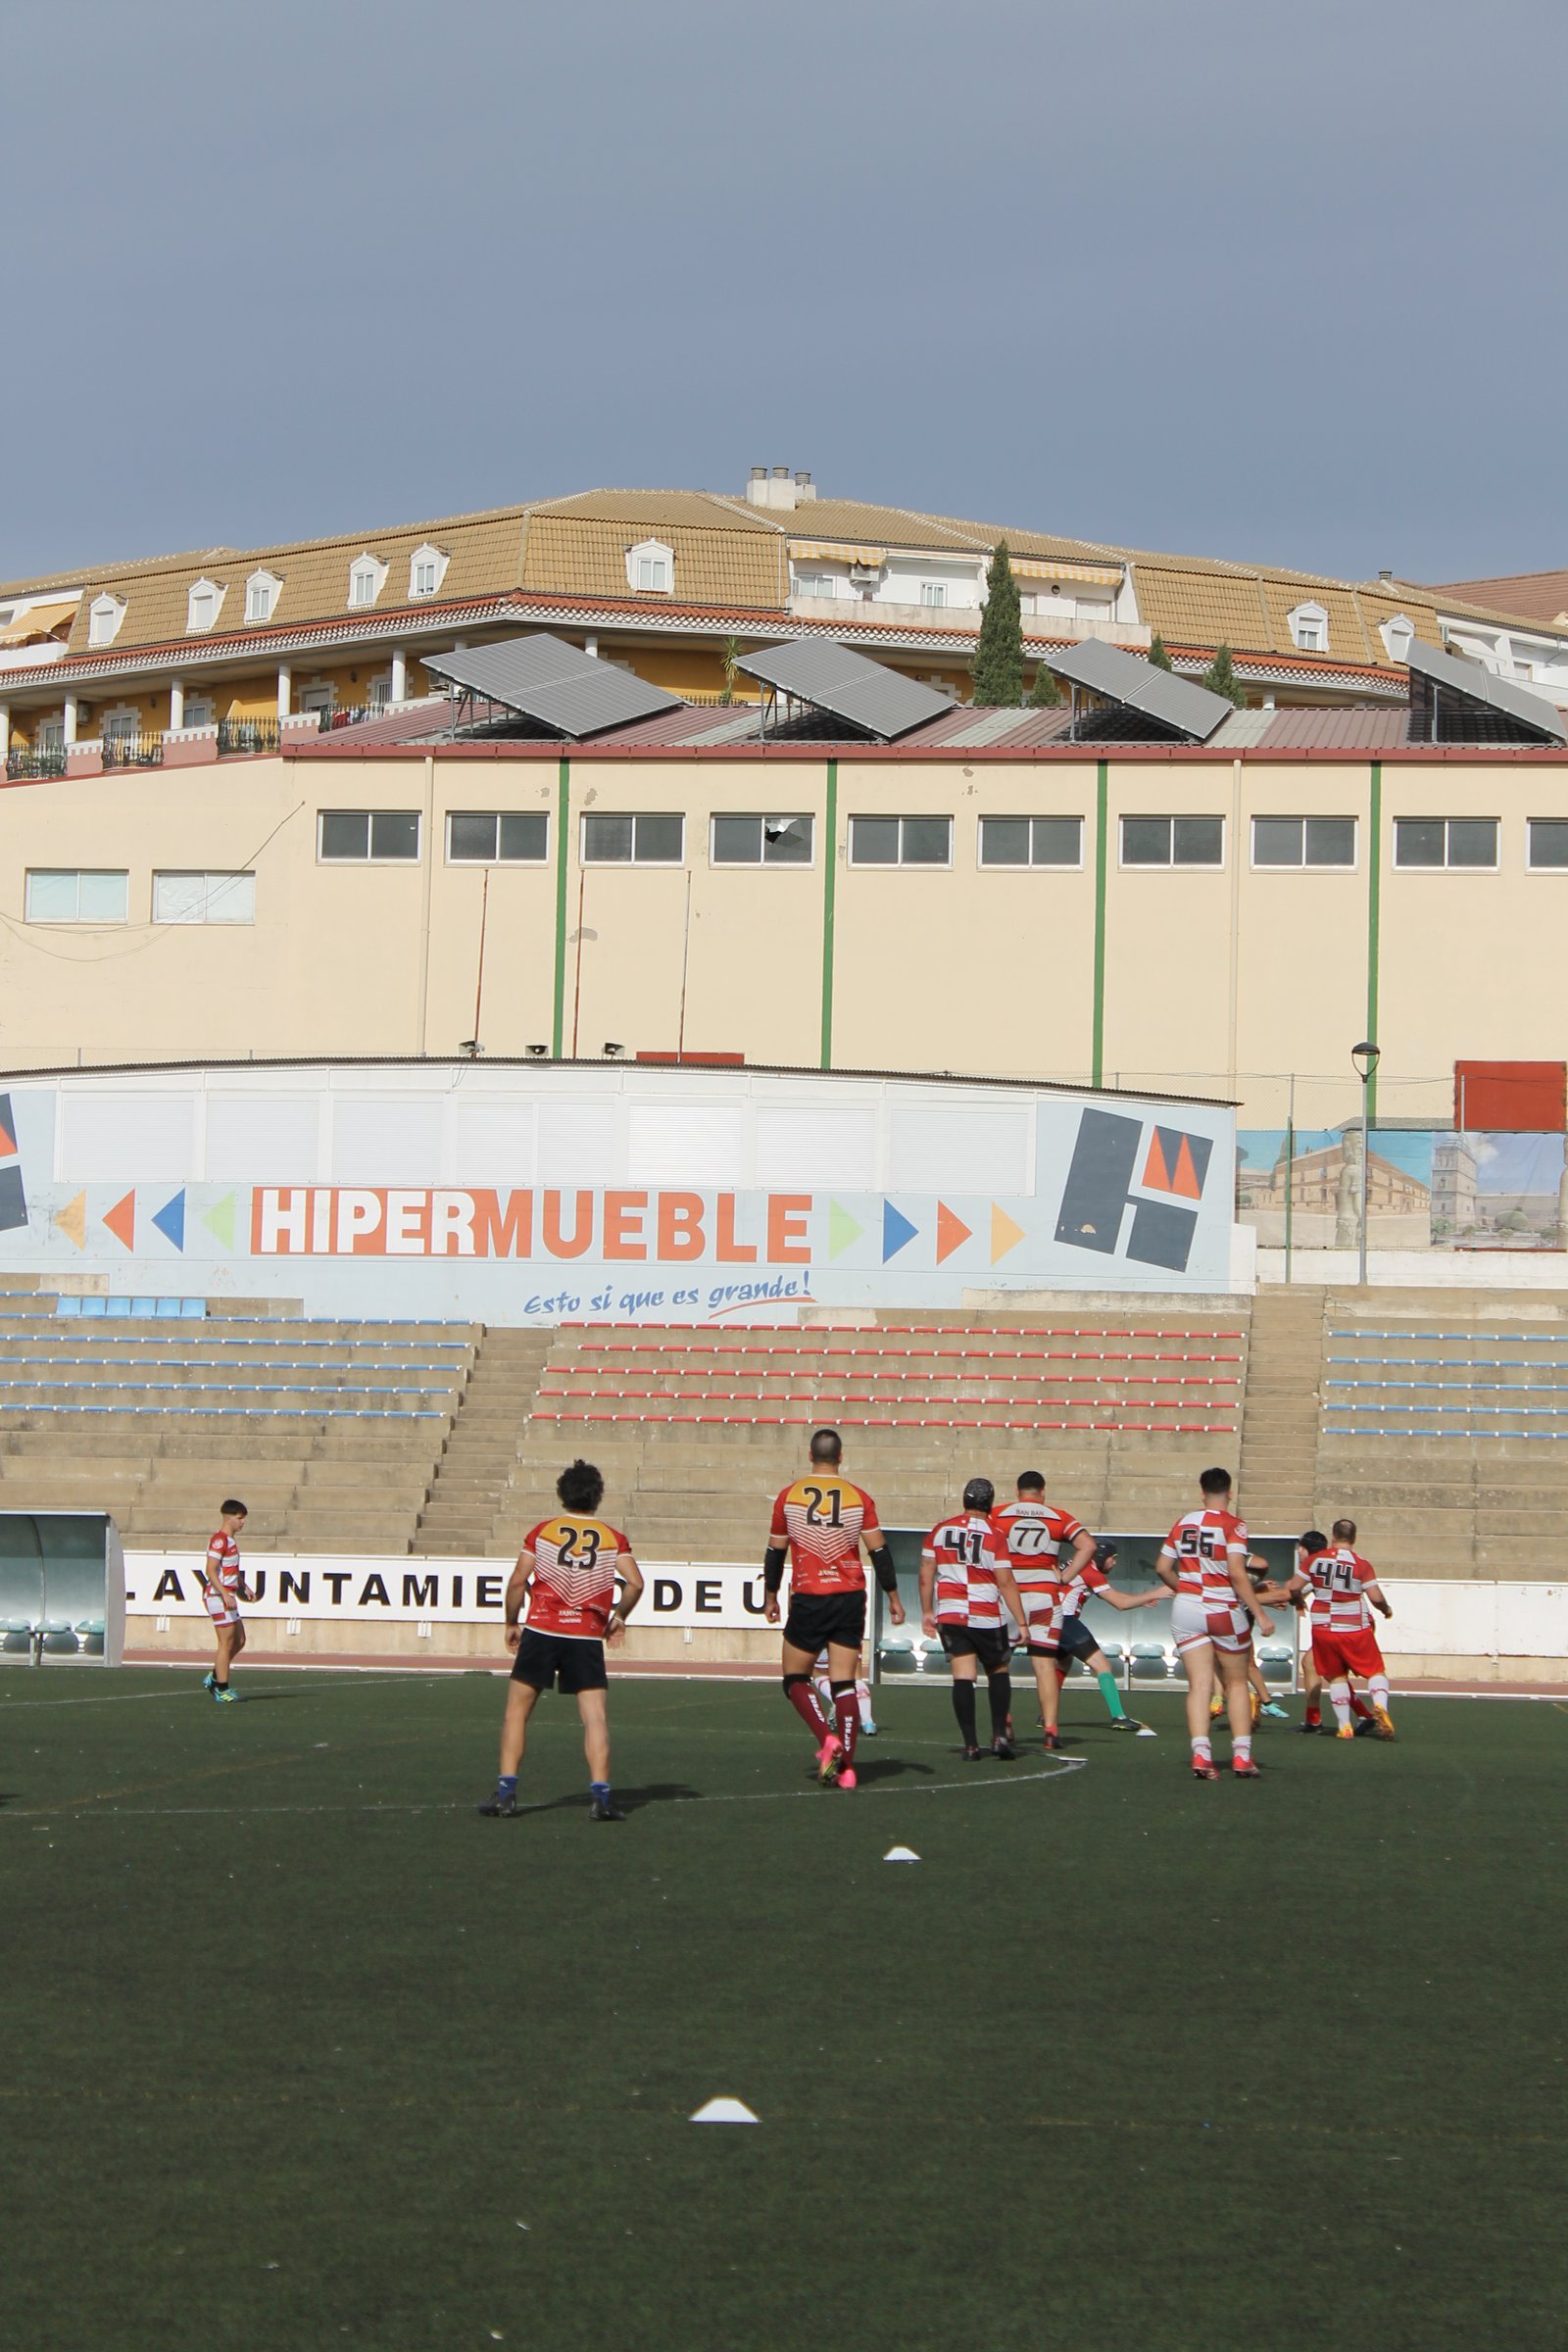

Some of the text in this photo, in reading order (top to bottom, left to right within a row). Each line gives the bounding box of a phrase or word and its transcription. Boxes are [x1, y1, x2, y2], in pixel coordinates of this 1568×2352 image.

[260, 1188, 812, 1263] HIPERMUEBLE
[523, 1291, 581, 1314] Esto
[618, 1289, 664, 1316] que
[672, 1287, 699, 1304] es
[708, 1270, 810, 1308] grande!
[804, 1487, 845, 1529] 21
[557, 1526, 601, 1571] 23
[943, 1528, 985, 1567] 41
[1014, 1527, 1046, 1547] 77
[1315, 1561, 1353, 1590] 44
[653, 1578, 723, 1613] DE
[844, 1716, 854, 1752] MORLEY
